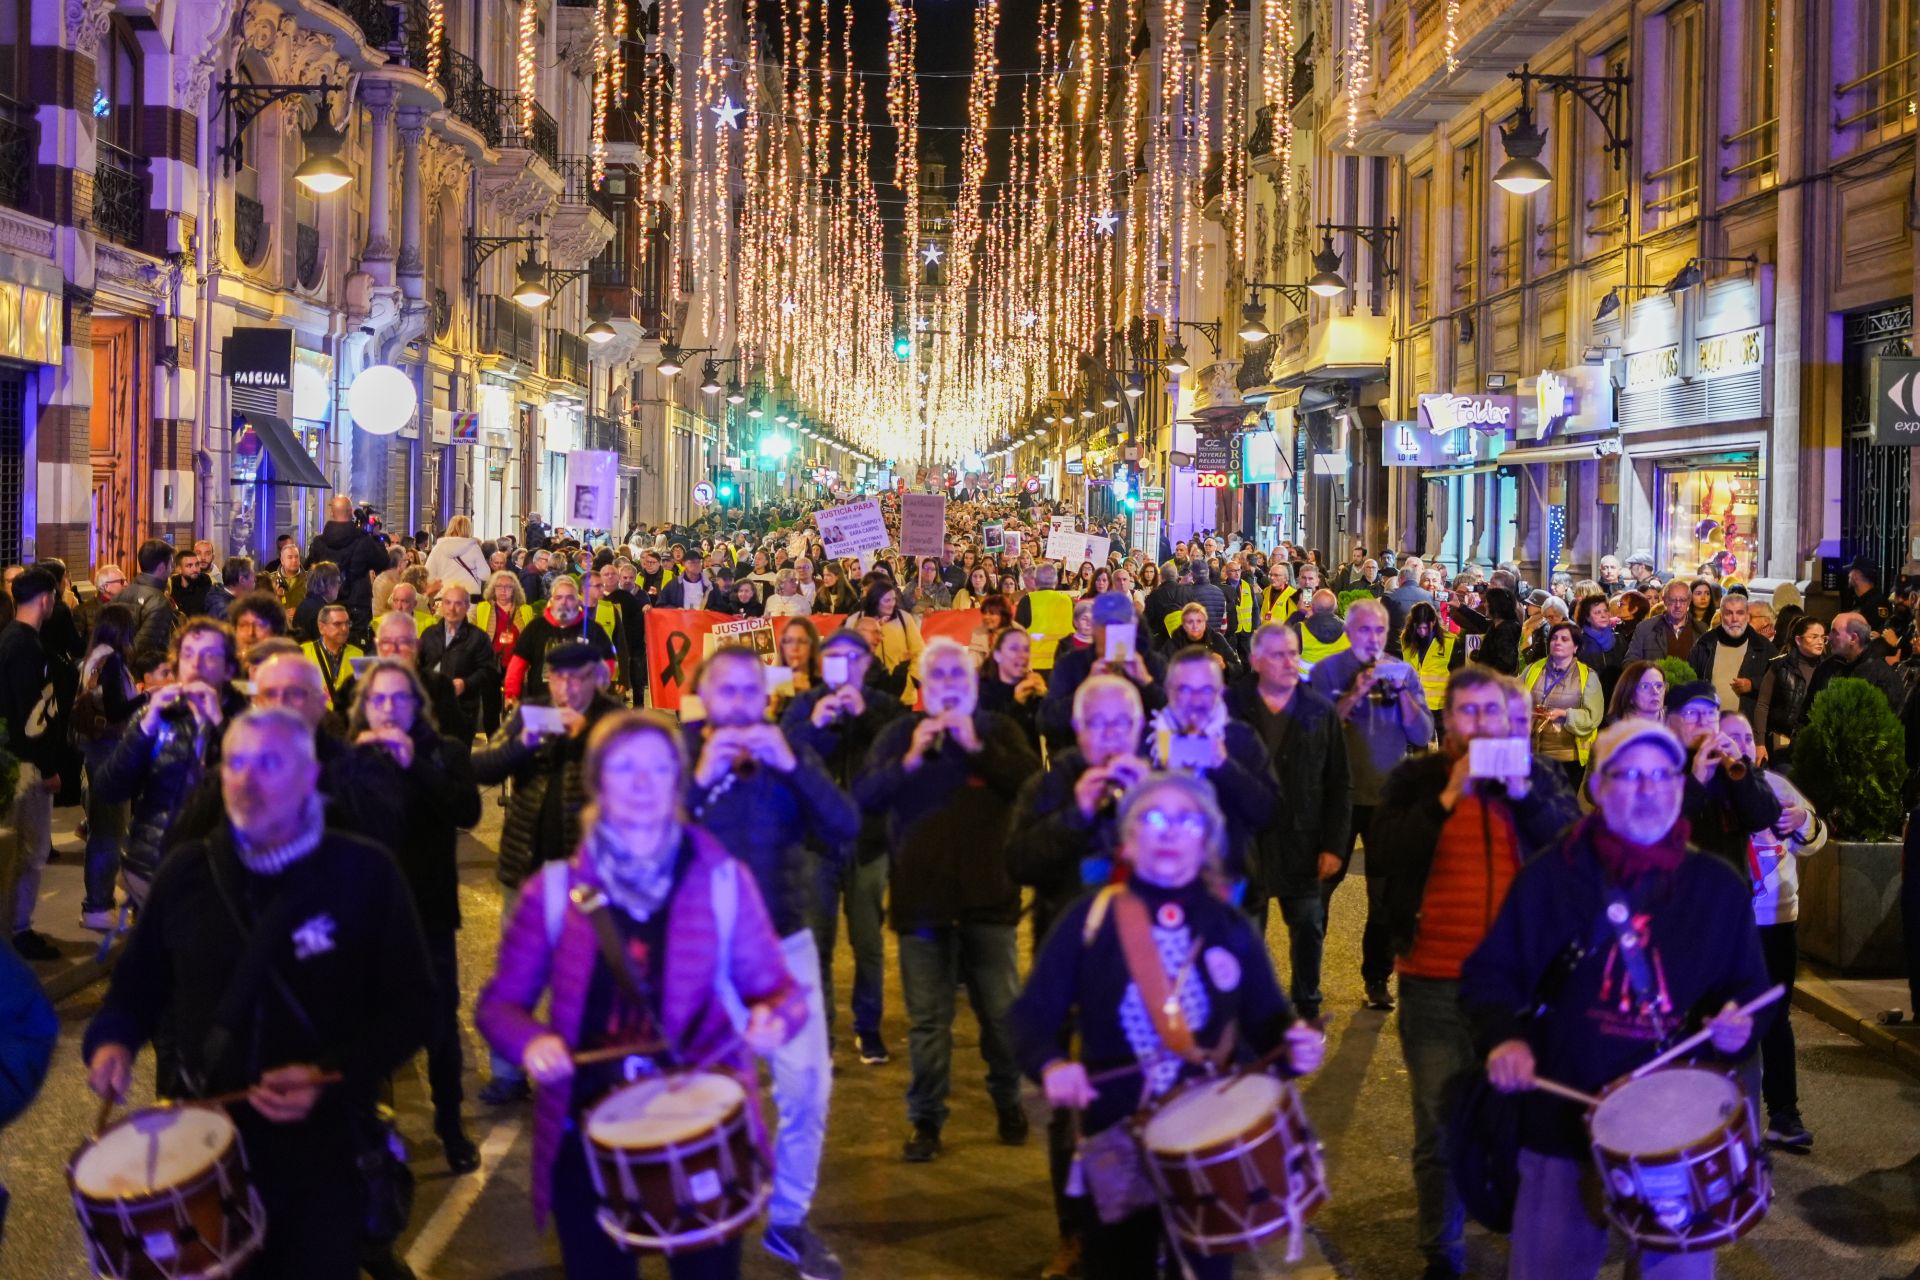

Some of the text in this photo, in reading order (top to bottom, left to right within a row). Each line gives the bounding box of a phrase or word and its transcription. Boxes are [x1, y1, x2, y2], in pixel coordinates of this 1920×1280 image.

[235, 371, 287, 385] PASCUAL
[1449, 397, 1510, 424] Folder
[1230, 439, 1240, 470] ORO
[853, 502, 875, 512] PARA
[714, 619, 771, 635] JUSTICIA
